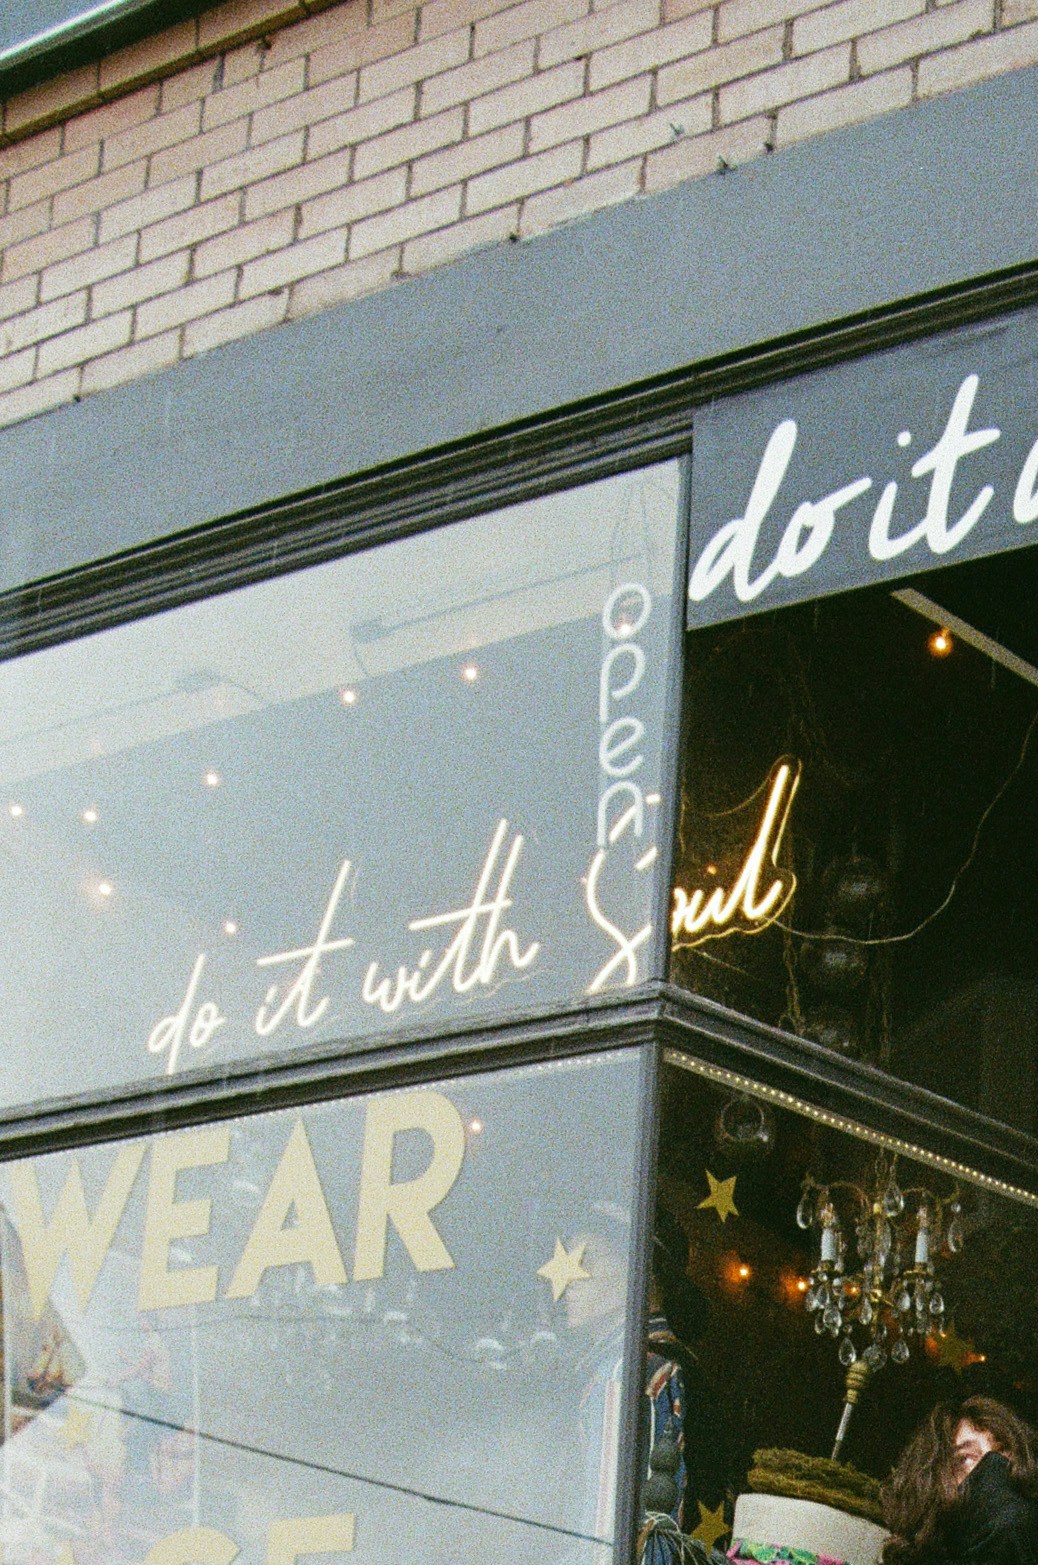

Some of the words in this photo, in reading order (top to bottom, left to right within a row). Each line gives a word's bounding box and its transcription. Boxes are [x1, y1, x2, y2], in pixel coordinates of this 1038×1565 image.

[688, 418, 873, 603] do
[866, 373, 1001, 562] it
[147, 953, 228, 1075] do
[254, 859, 356, 1038] it
[362, 818, 540, 1013] with
[7, 1090, 467, 1321] WEAR
